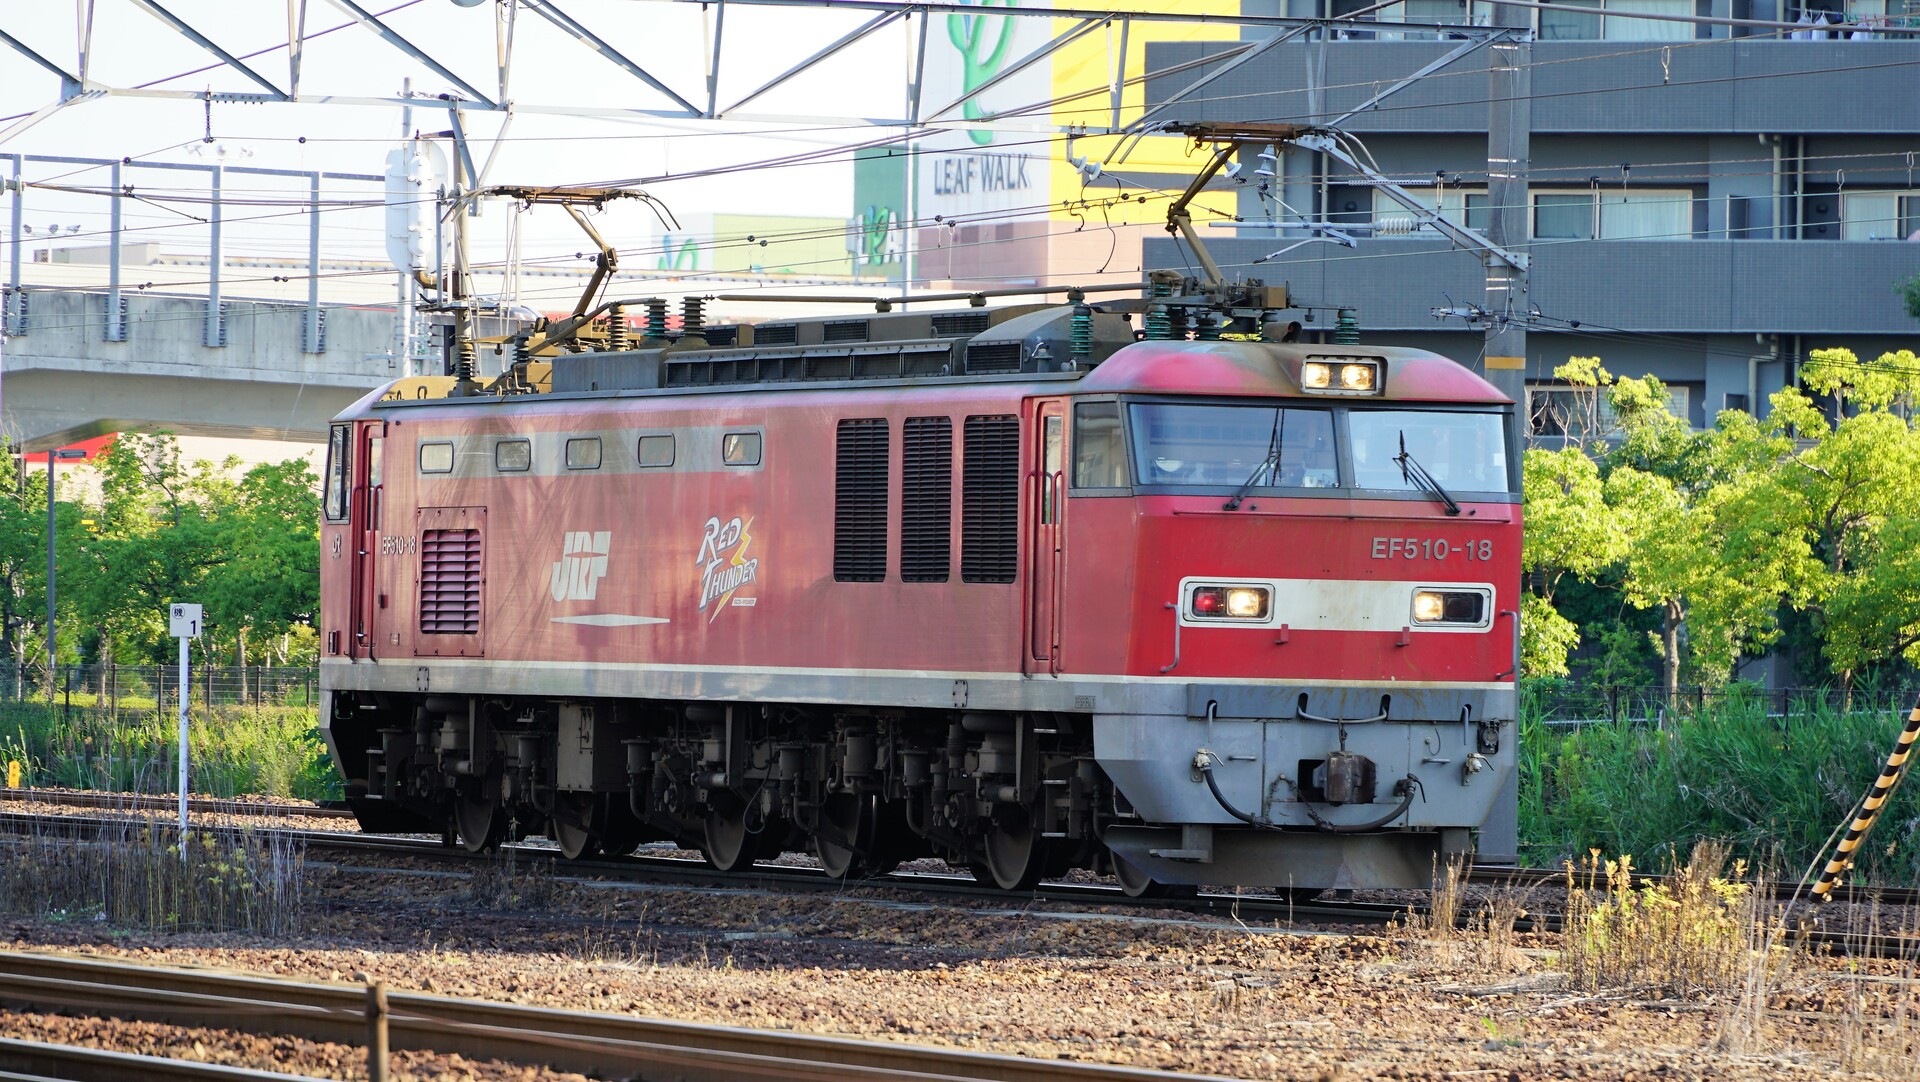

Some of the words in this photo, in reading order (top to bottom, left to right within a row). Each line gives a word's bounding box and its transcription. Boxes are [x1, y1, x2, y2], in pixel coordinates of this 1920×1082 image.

[934, 157, 975, 195] LEAF
[980, 153, 1030, 192] WALK
[382, 536, 416, 556] EF510-18
[696, 516, 742, 566] RED
[1371, 537, 1493, 561] EF510-18
[699, 558, 758, 609] THUNDER
[190, 619, 196, 635] 1
